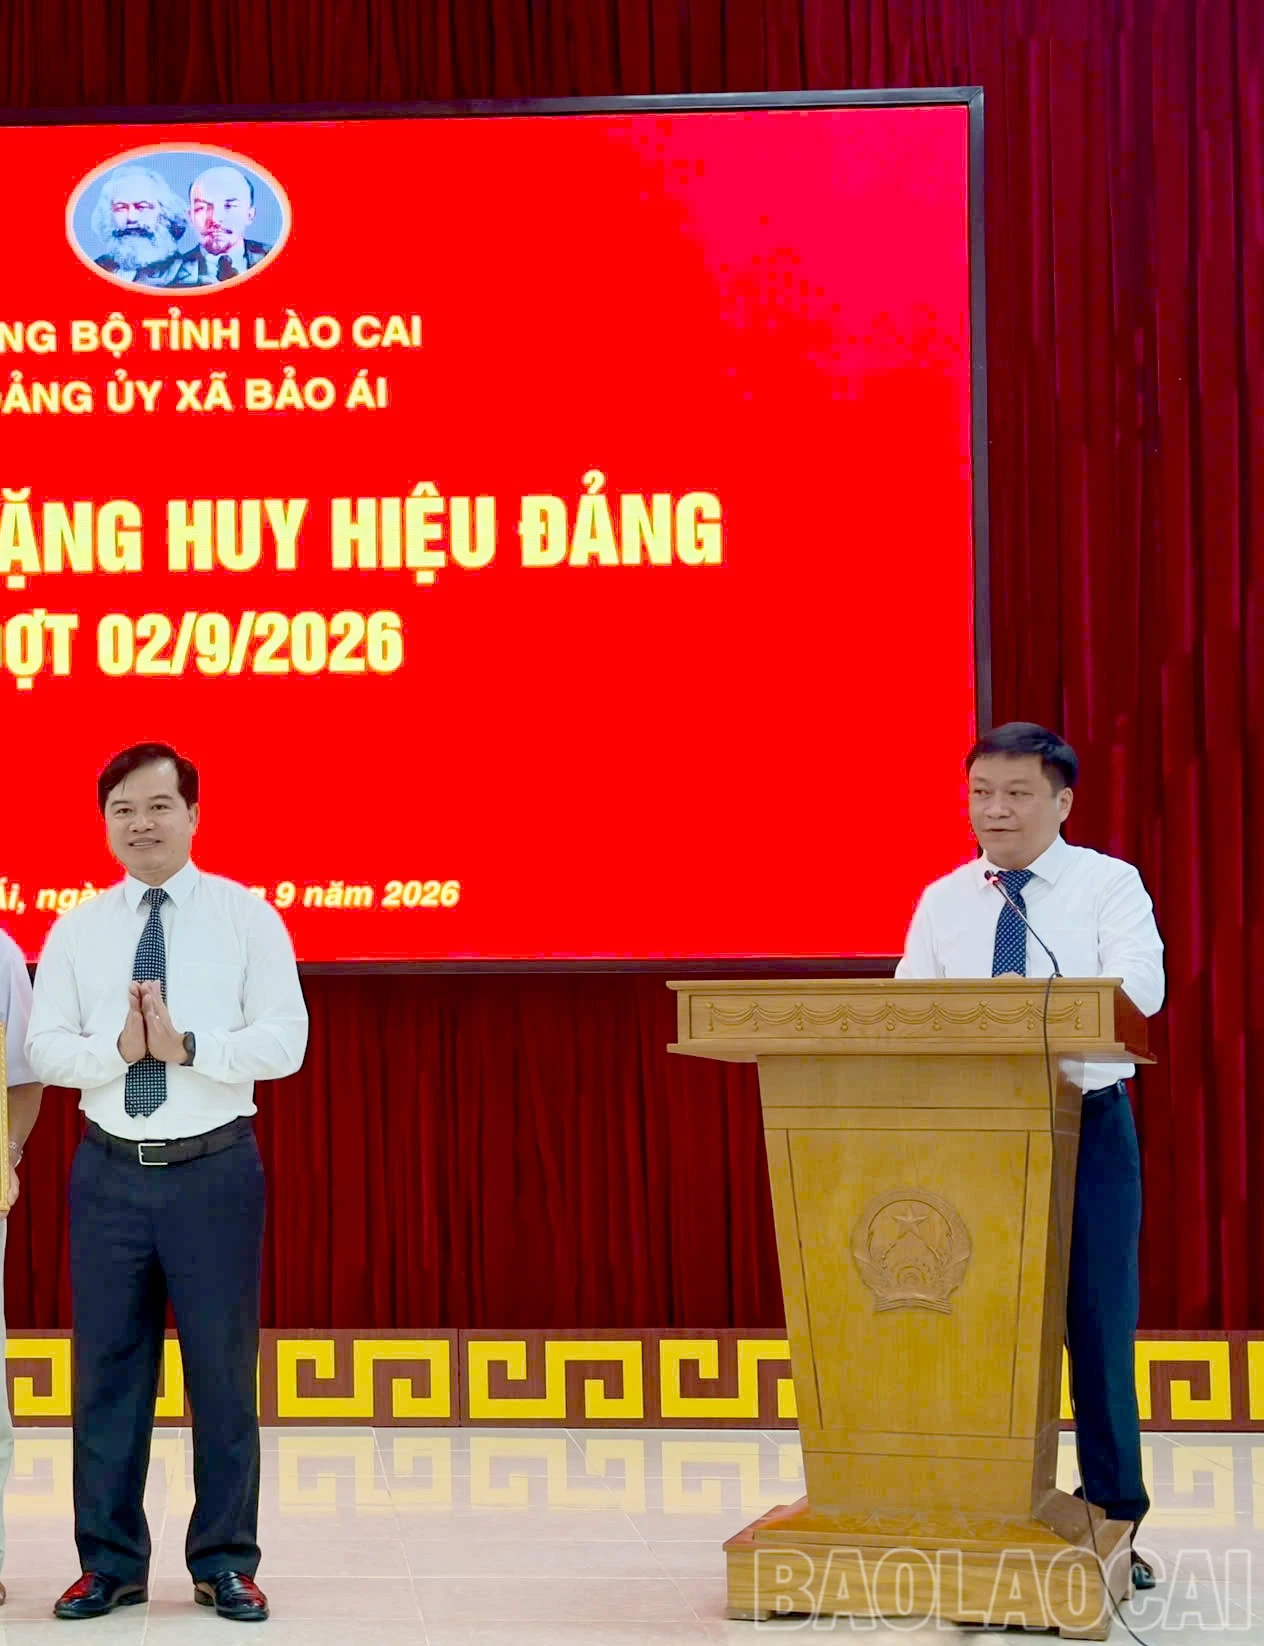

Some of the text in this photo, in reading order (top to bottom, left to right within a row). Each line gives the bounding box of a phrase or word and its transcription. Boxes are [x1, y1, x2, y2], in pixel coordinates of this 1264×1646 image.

[72, 312, 132, 358] BỘ
[142, 307, 240, 350] TỈNH
[255, 309, 341, 349] LÀO
[352, 315, 421, 348] CAI
[107, 369, 162, 413] ỦY
[176, 372, 233, 412] XÃ
[246, 366, 336, 410] BẢO
[346, 369, 388, 408] ÁI
[168, 498, 308, 572] HUY
[331, 481, 496, 584] HIỆU
[518, 470, 722, 567] ĐẢNG
[97, 610, 404, 676] 02/9/2026
[275, 881, 296, 908] 9
[303, 881, 374, 908] năm
[381, 880, 460, 908] 2026
